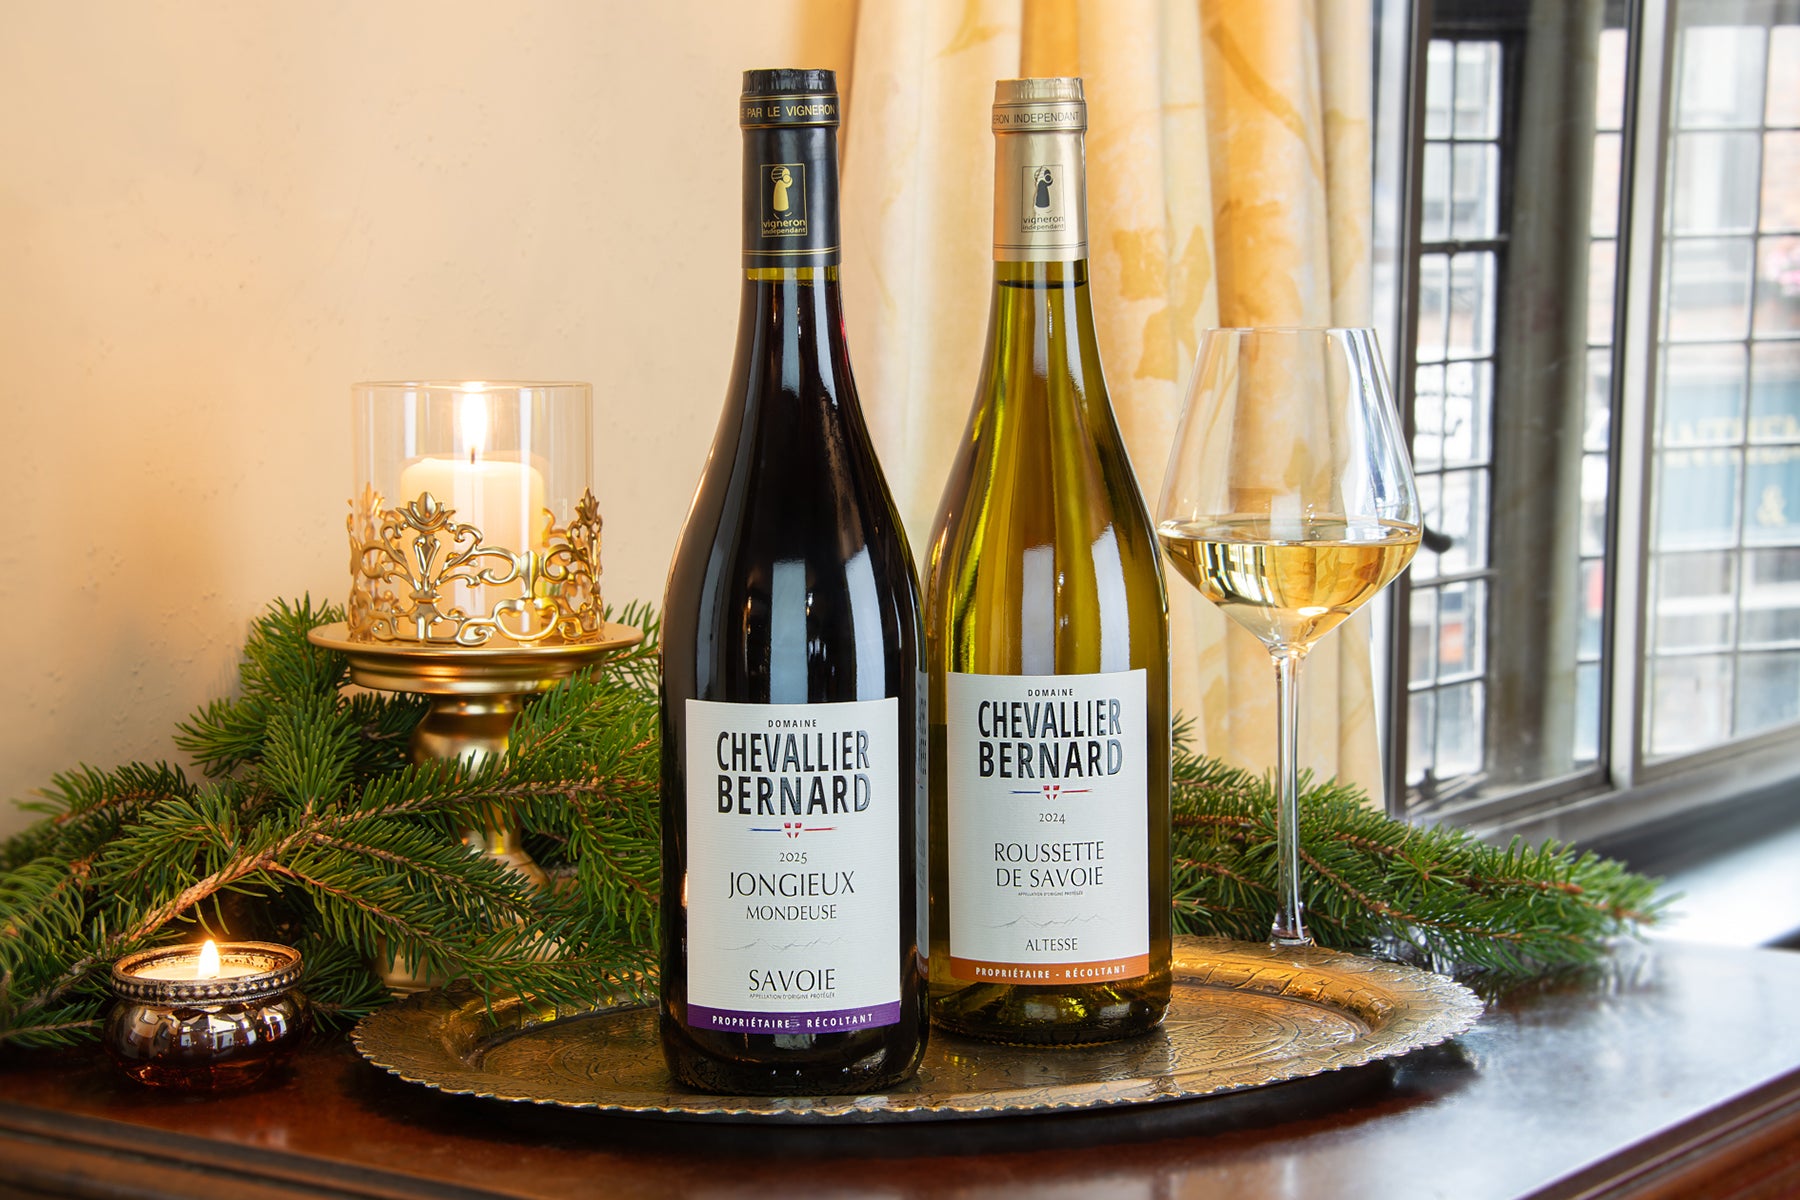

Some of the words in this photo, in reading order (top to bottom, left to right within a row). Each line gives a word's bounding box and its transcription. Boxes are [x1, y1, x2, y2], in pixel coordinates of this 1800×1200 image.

[747, 107, 763, 118] PAR
[767, 106, 780, 117] LE
[786, 104, 835, 116] VIGNERON
[1014, 111, 1079, 123] INDEPENDANT
[763, 219, 806, 228] vigneron
[1023, 215, 1064, 224] vigneron
[1027, 688, 1074, 697] DOMAINE
[768, 719, 818, 728] DOMAINE
[978, 698, 1122, 739] CHEVALLIER
[716, 730, 871, 773] CHEVALLIER
[979, 739, 1123, 779] BERNARD
[717, 773, 872, 816] BERNARD
[1038, 813, 1066, 825] 2024
[778, 852, 808, 865] 2025
[994, 841, 1105, 863] ROUSSETTE
[728, 870, 856, 899] JONGIEUX
[996, 868, 1022, 887] DE
[1030, 866, 1104, 888] SAVOIE
[746, 904, 837, 921] MONDEUSE
[1025, 937, 1078, 951] ALTESSE
[975, 966, 1050, 979] PROPRIÉTAIRE
[1065, 964, 1126, 979] RÉCOLTANT
[749, 968, 836, 992] SAVOIE
[712, 1015, 790, 1029] PROPRIÉTAIRE
[806, 1013, 873, 1028] RÉCOLTANT
